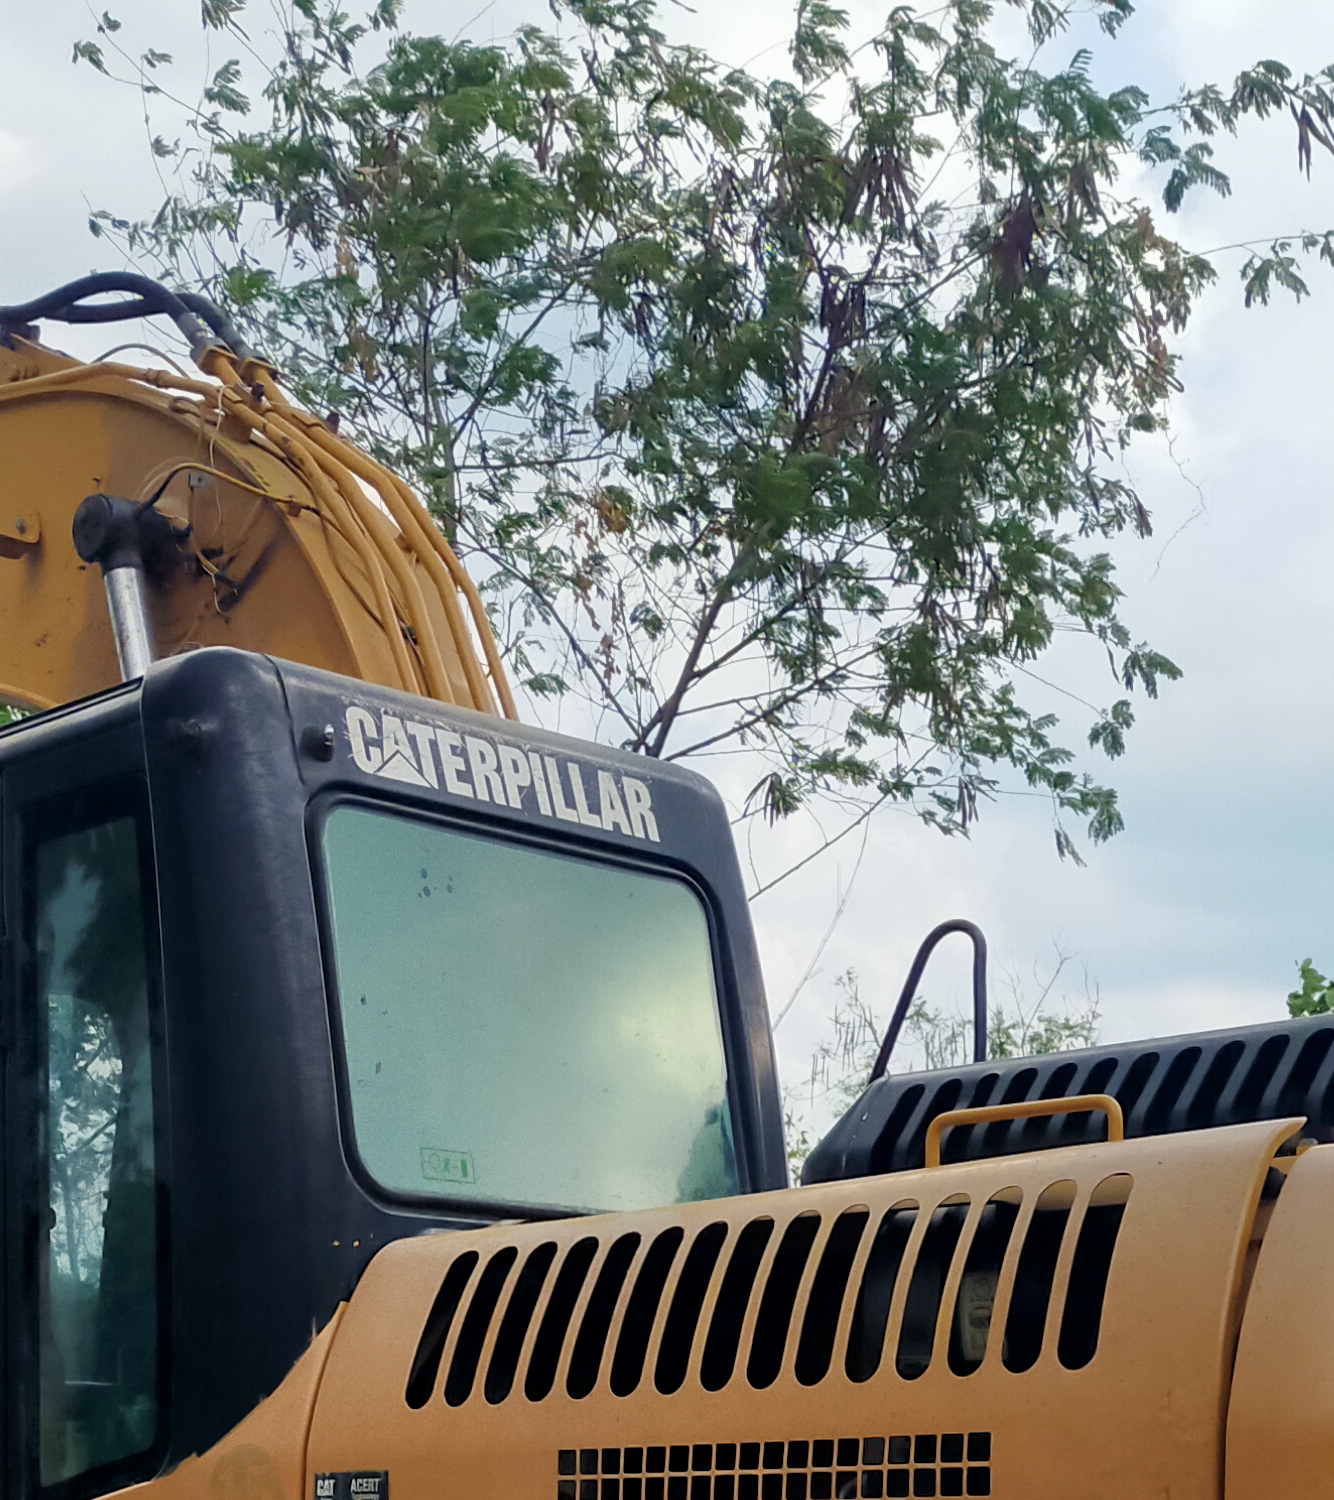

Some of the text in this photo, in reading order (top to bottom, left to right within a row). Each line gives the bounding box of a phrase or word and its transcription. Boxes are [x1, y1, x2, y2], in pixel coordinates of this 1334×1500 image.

[345, 706, 660, 842] CATERPILLAR
[317, 1479, 336, 1497] CAT
[350, 1478, 380, 1493] ACERT
